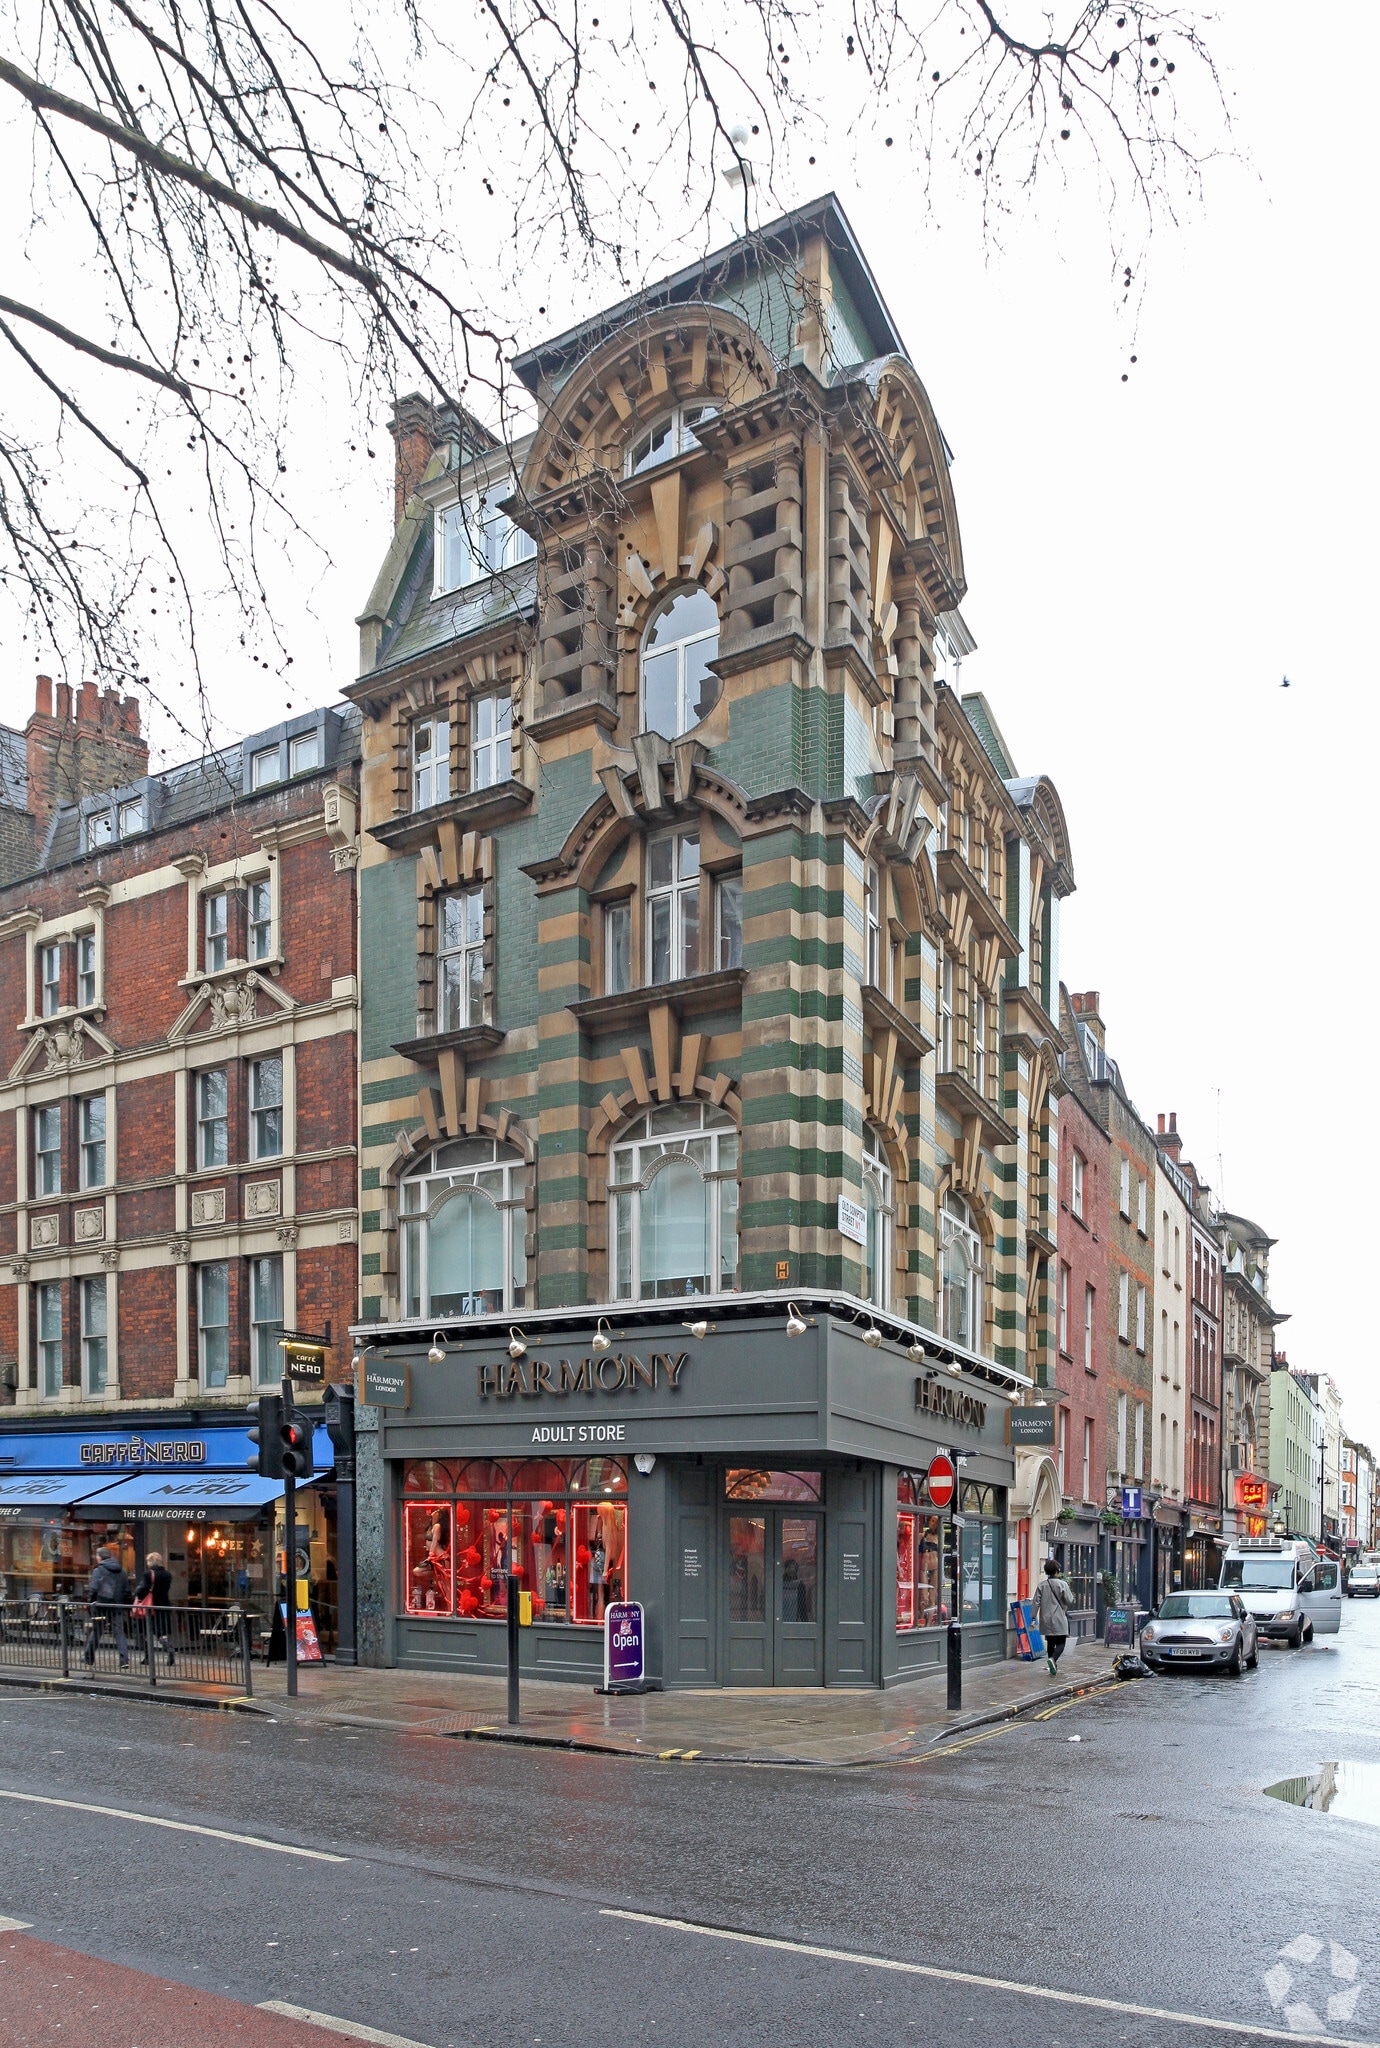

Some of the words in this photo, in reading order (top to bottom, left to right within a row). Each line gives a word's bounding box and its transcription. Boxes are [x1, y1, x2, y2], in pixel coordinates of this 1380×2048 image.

[291, 1363, 321, 1375] NERO
[375, 1385, 397, 1393] LONDON
[532, 1426, 576, 1442] ADULT
[578, 1425, 625, 1441] STORE
[80, 1435, 144, 1465] CAFFÈ
[144, 1441, 207, 1464] NERO
[149, 1484, 250, 1495] NERO
[123, 1509, 136, 1518] THE
[138, 1509, 164, 1518] ITALIAN
[166, 1510, 194, 1519] COFFEE
[612, 1633, 639, 1651] Open
